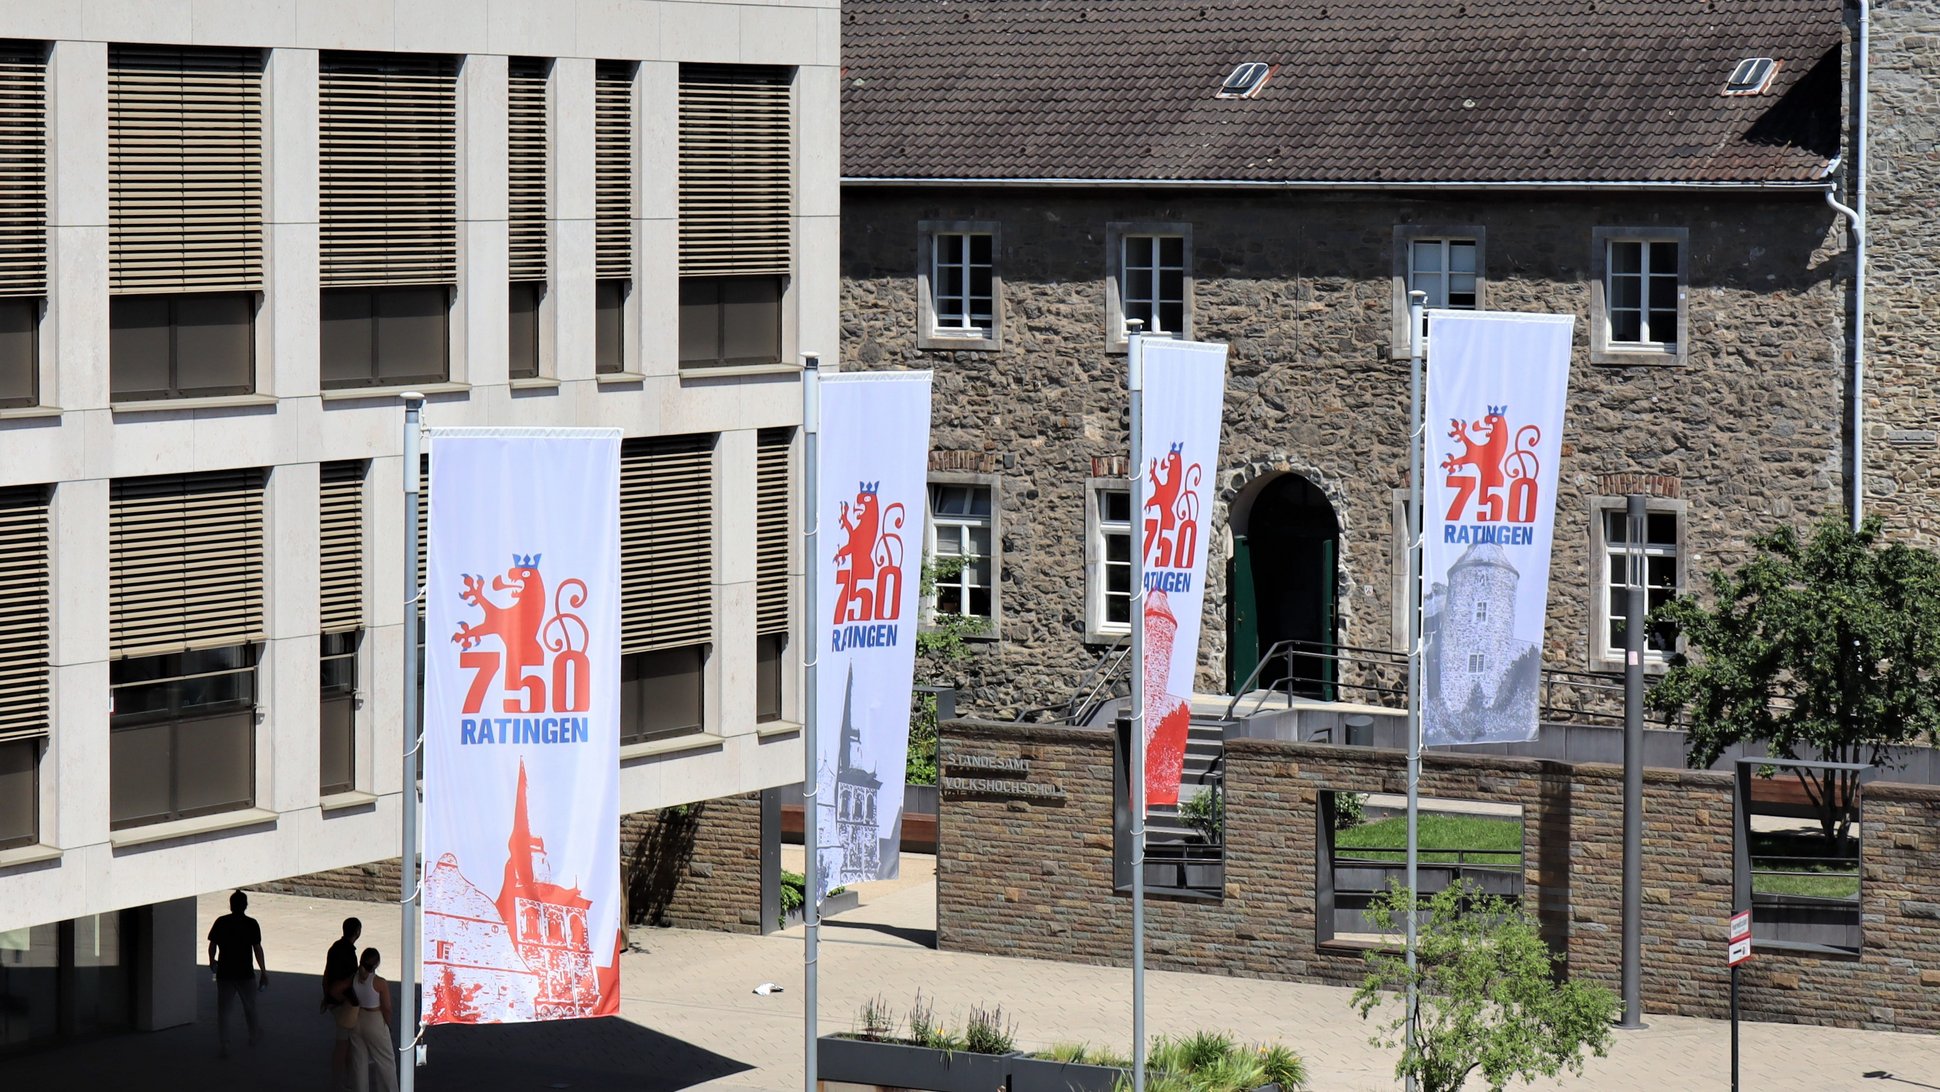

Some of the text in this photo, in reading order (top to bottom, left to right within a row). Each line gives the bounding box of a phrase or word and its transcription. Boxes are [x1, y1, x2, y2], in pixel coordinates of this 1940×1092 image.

[1445, 476, 1538, 523] 750
[1143, 518, 1197, 568] 750
[1444, 524, 1533, 545] RATINGEN
[833, 565, 903, 625] 750
[1143, 571, 1192, 593] ATGEN
[831, 623, 898, 652] RAINGEN
[459, 650, 591, 714] 750
[460, 717, 589, 745] RATINGEN
[947, 753, 1031, 772] STANDESAMT
